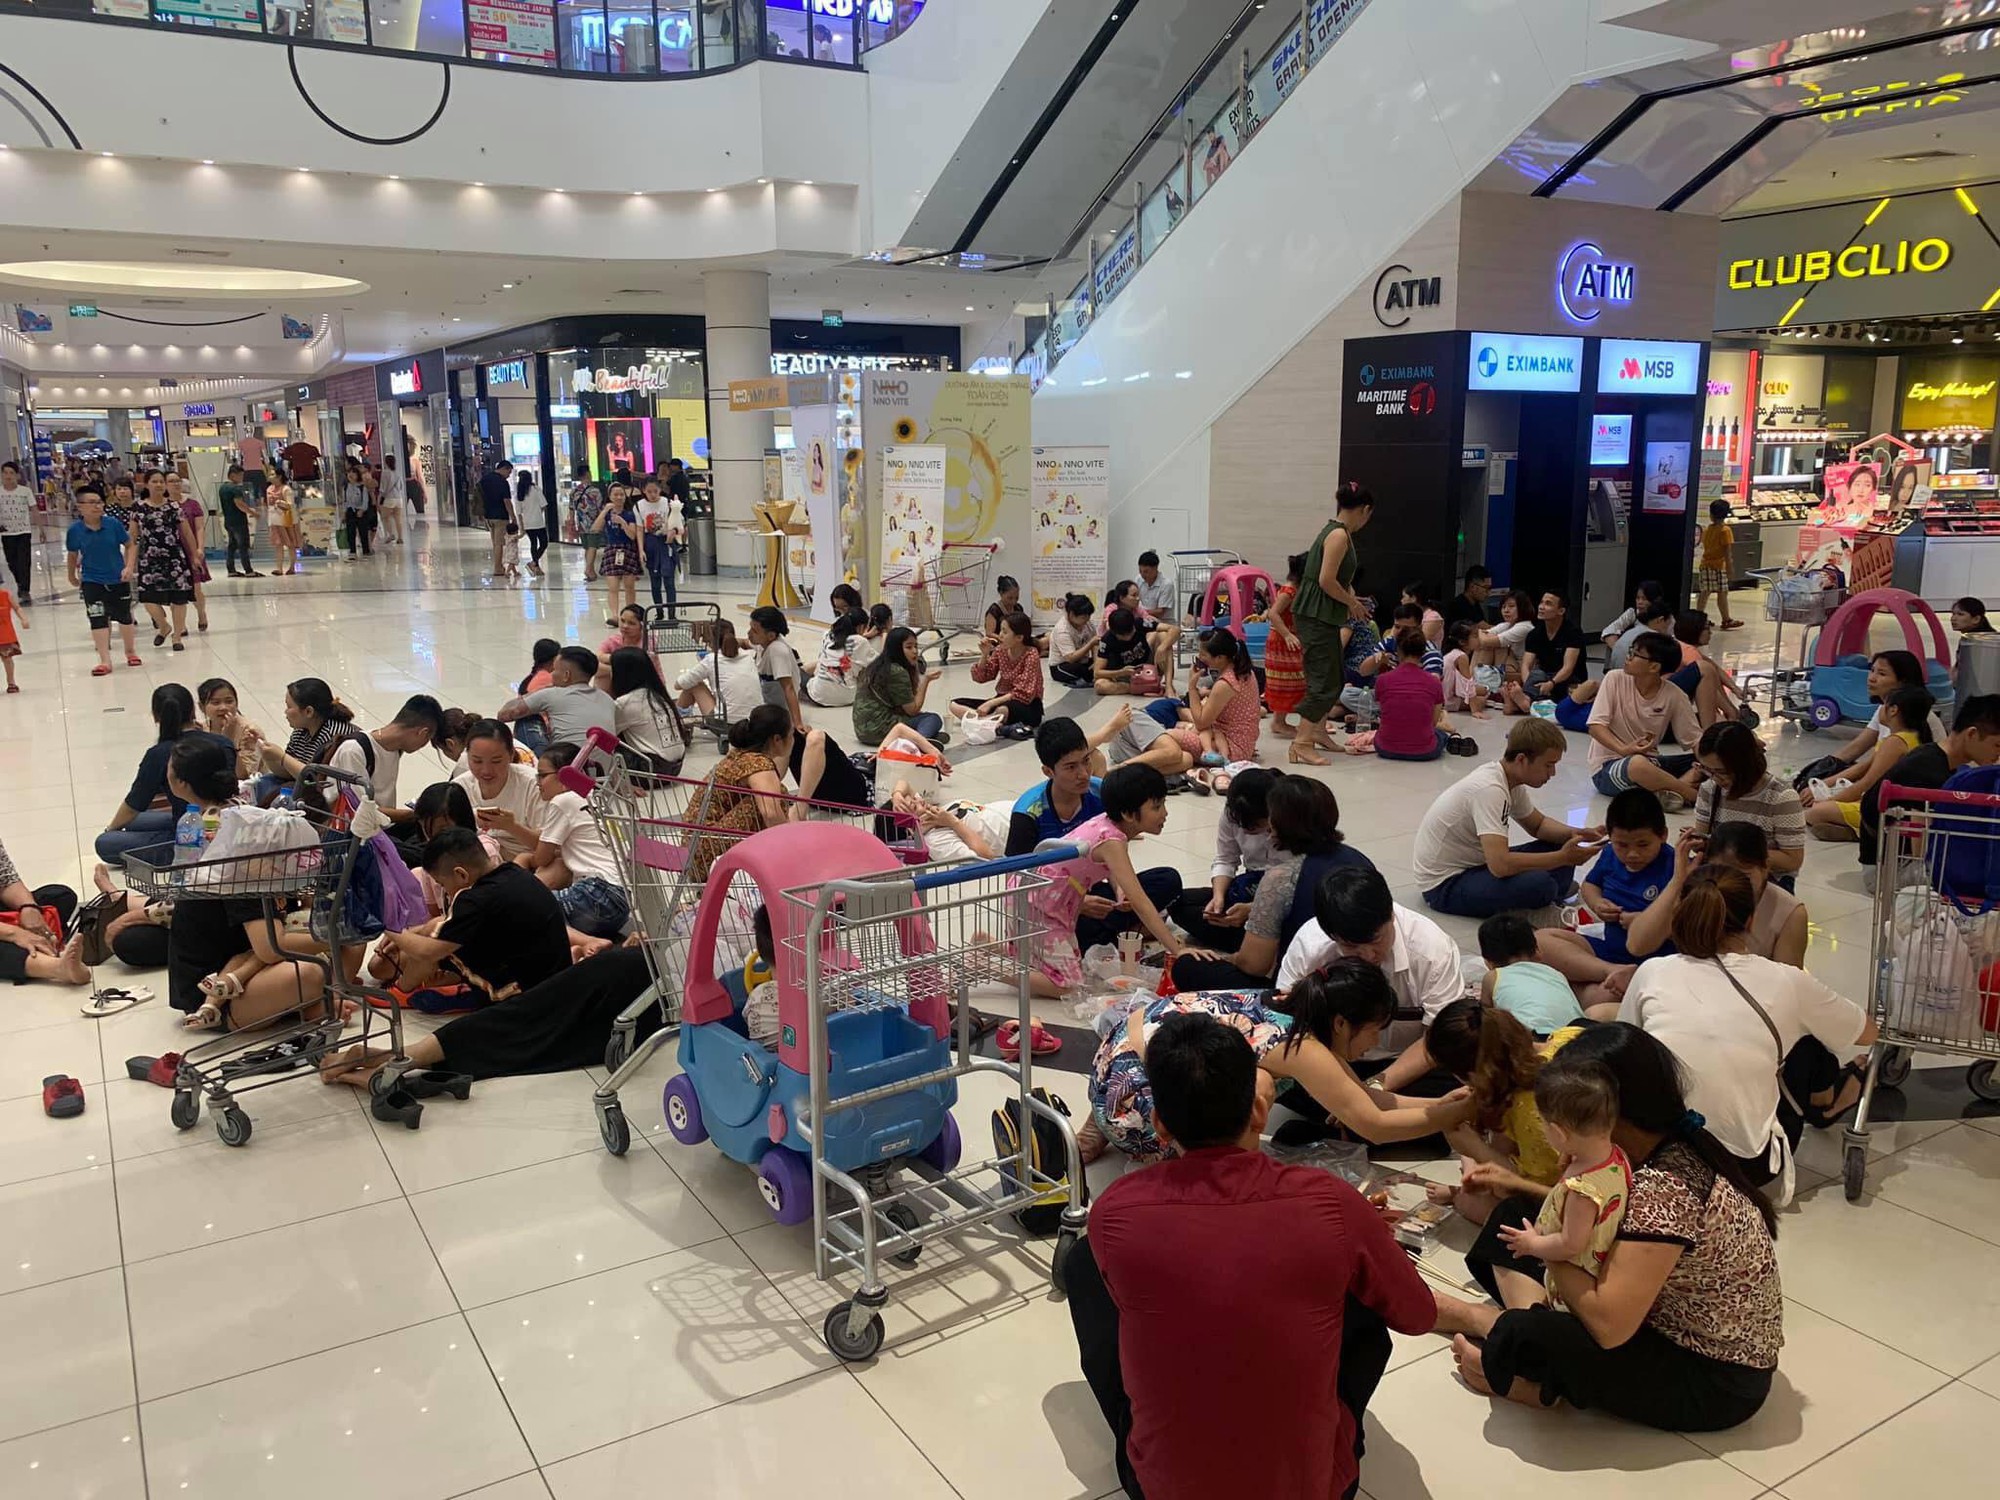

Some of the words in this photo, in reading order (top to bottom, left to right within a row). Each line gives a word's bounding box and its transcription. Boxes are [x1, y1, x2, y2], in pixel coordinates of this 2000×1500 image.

[1578, 264, 1634, 300] ATM
[1384, 276, 1441, 310] ATM
[1507, 347, 1574, 374] EXIMBANK
[1644, 359, 1675, 379] MSB
[489, 364, 510, 385] BEAUTY
[1381, 365, 1435, 380] EXIMBANK
[872, 379, 909, 397] NNO
[1357, 388, 1408, 404] MARITIME
[873, 397, 891, 406] NNO
[892, 397, 909, 406] VITE
[1376, 403, 1405, 415] BANK
[887, 460, 904, 469] NNO
[908, 461, 925, 469] NNO
[925, 461, 941, 469] VITE
[1036, 460, 1057, 468] NNO
[1064, 460, 1084, 468] NNO
[1085, 460, 1105, 468] VITE
